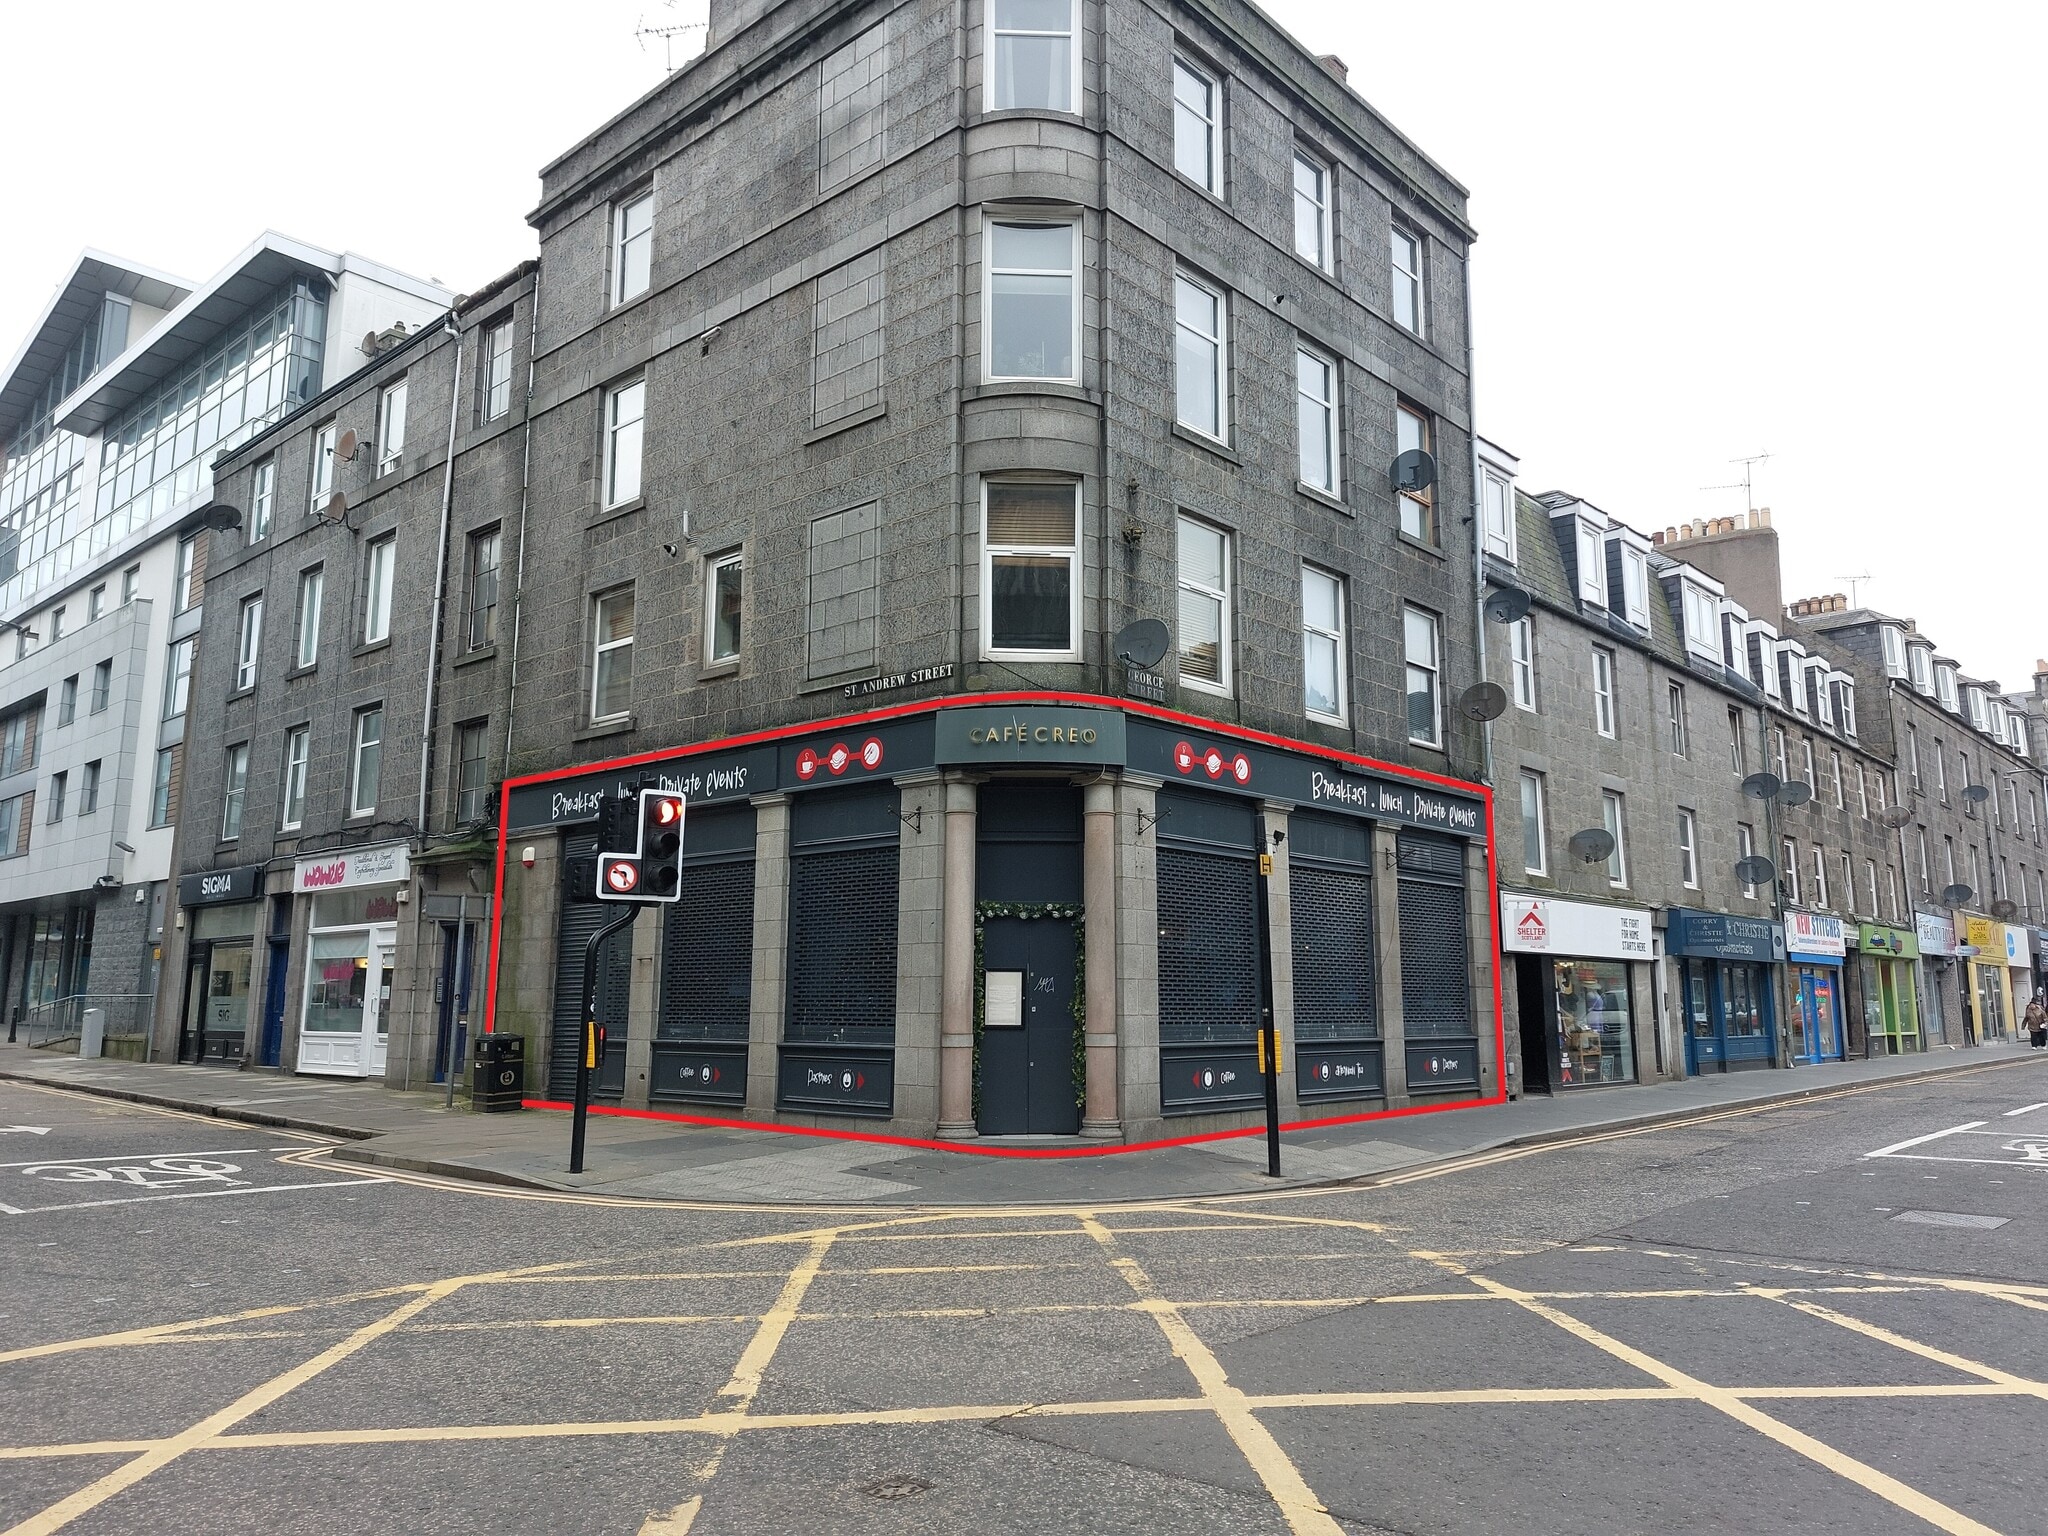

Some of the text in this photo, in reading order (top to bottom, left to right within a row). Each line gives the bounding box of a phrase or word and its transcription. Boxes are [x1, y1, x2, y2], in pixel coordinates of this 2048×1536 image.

[844, 663, 954, 697] ST ANDREW STREET
[1127, 669, 1165, 689] GEORGE
[1127, 681, 1165, 701] STREET
[969, 722, 1097, 745] CAFÉ CREO
[201, 874, 231, 895] SIGMA
[1517, 927, 1546, 936] SHELTER
[1620, 917, 1640, 928] THE FIGHT
[1733, 921, 1770, 940] CHRISTIE
[1795, 913, 1811, 935] NEW
[1811, 916, 1841, 938] STITCHES
[1621, 929, 1640, 940] FOR HOME
[1621, 940, 1647, 952] STARTS HERE
